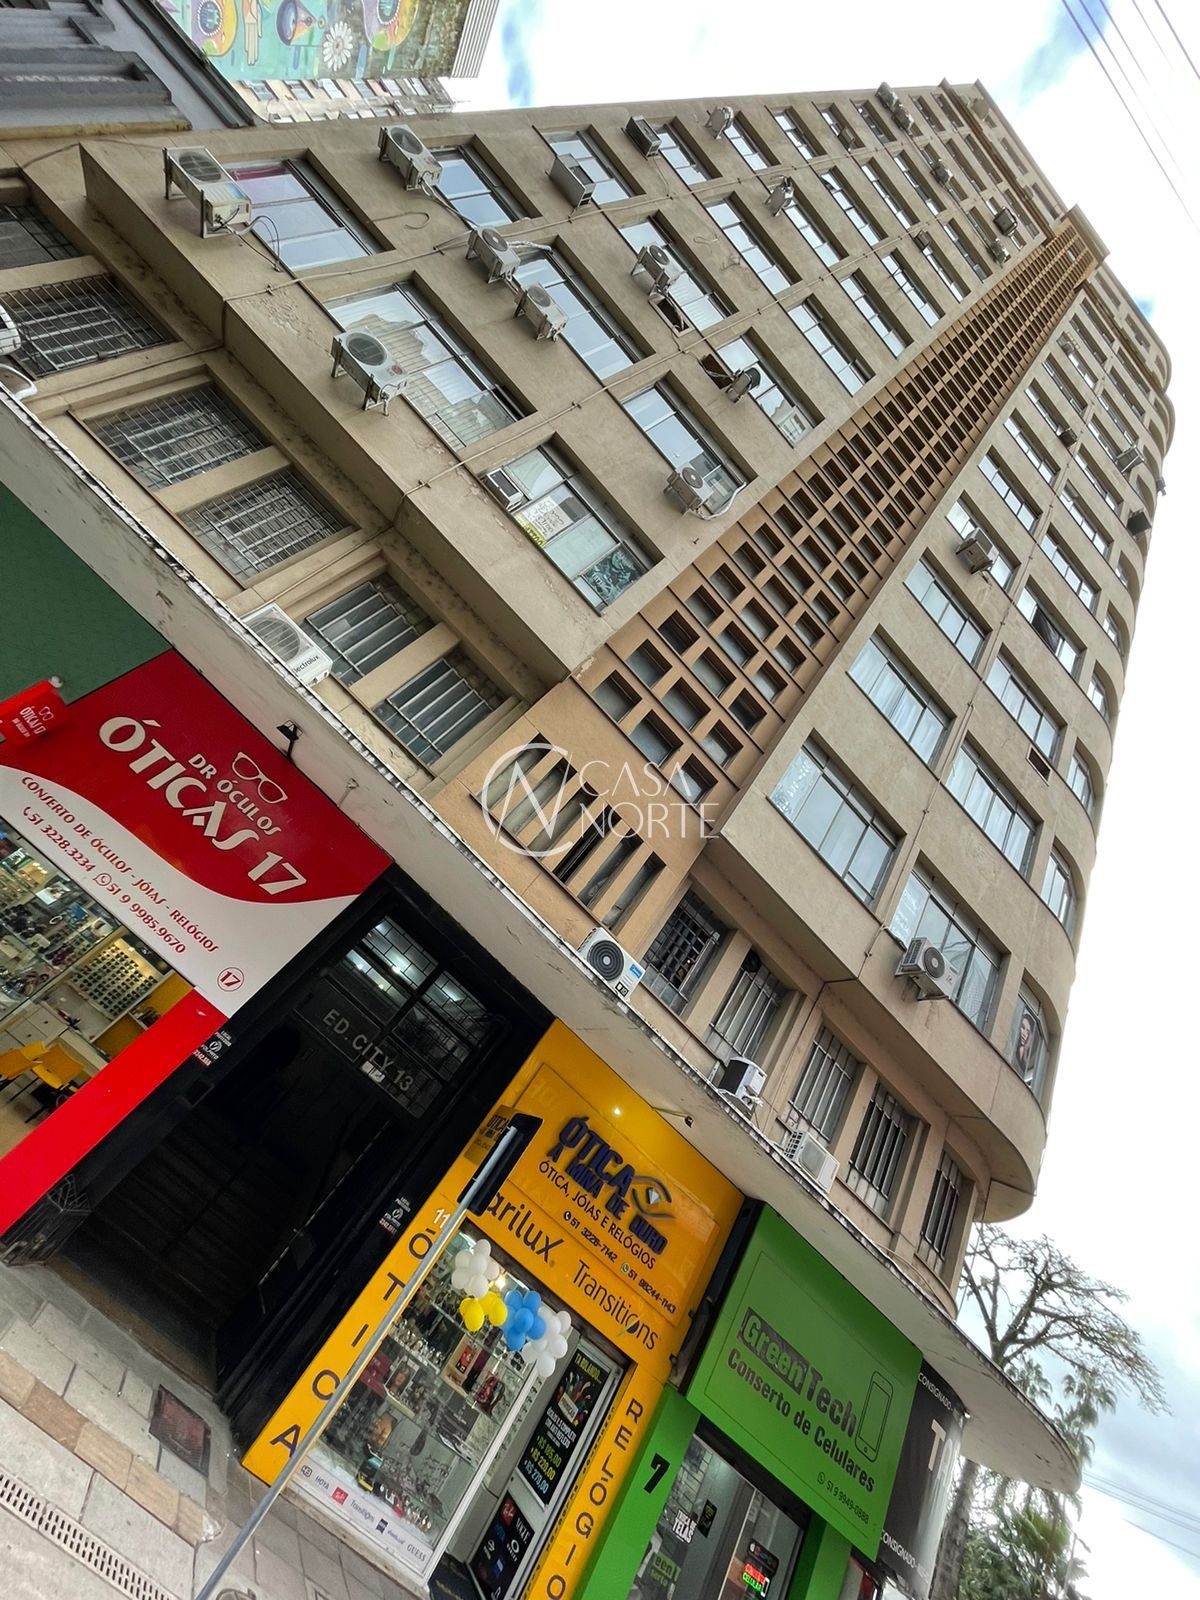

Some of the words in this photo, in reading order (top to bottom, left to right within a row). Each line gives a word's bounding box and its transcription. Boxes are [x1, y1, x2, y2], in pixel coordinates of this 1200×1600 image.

[98, 716, 260, 850] ÓTICAS
[248, 851, 307, 895] 17
[188, 753, 217, 779] DR
[217, 779, 281, 836] ÓCULOS
[21, 776, 75, 825] CONSERTO
[73, 819, 93, 840] DE
[90, 837, 132, 875] ÓCULOS
[132, 876, 167, 906] JÓIAS
[169, 909, 220, 954] RELÓGIOS
[28, 811, 43, 826] 51
[40, 823, 96, 873] 3228.3234
[106, 884, 122, 898] 51
[119, 892, 131, 905] 9
[129, 902, 186, 954] 9985.9670
[220, 970, 241, 988] 17
[352, 1034, 394, 1072] CITY
[393, 1070, 414, 1092] 13
[546, 1142, 564, 1162] A
[559, 1116, 636, 1198] ÓTICA
[434, 1208, 450, 1229] 11
[538, 1160, 570, 1198] ÓTICA,
[572, 1190, 601, 1222] JÓIAS
[600, 1216, 610, 1228] E
[608, 1223, 656, 1270] RELÓGIOS
[570, 1218, 580, 1229] 51
[628, 1268, 638, 1280] 51
[487, 1192, 564, 1264] arilux
[572, 1259, 658, 1350] Transitions
[728, 1348, 791, 1417] Conserto
[794, 1410, 812, 1436] de
[814, 1426, 875, 1494] Celulares
[918, 1372, 952, 1411] CONSIGNADO
[644, 1453, 670, 1494] 7
[672, 1518, 694, 1543] TELAS
